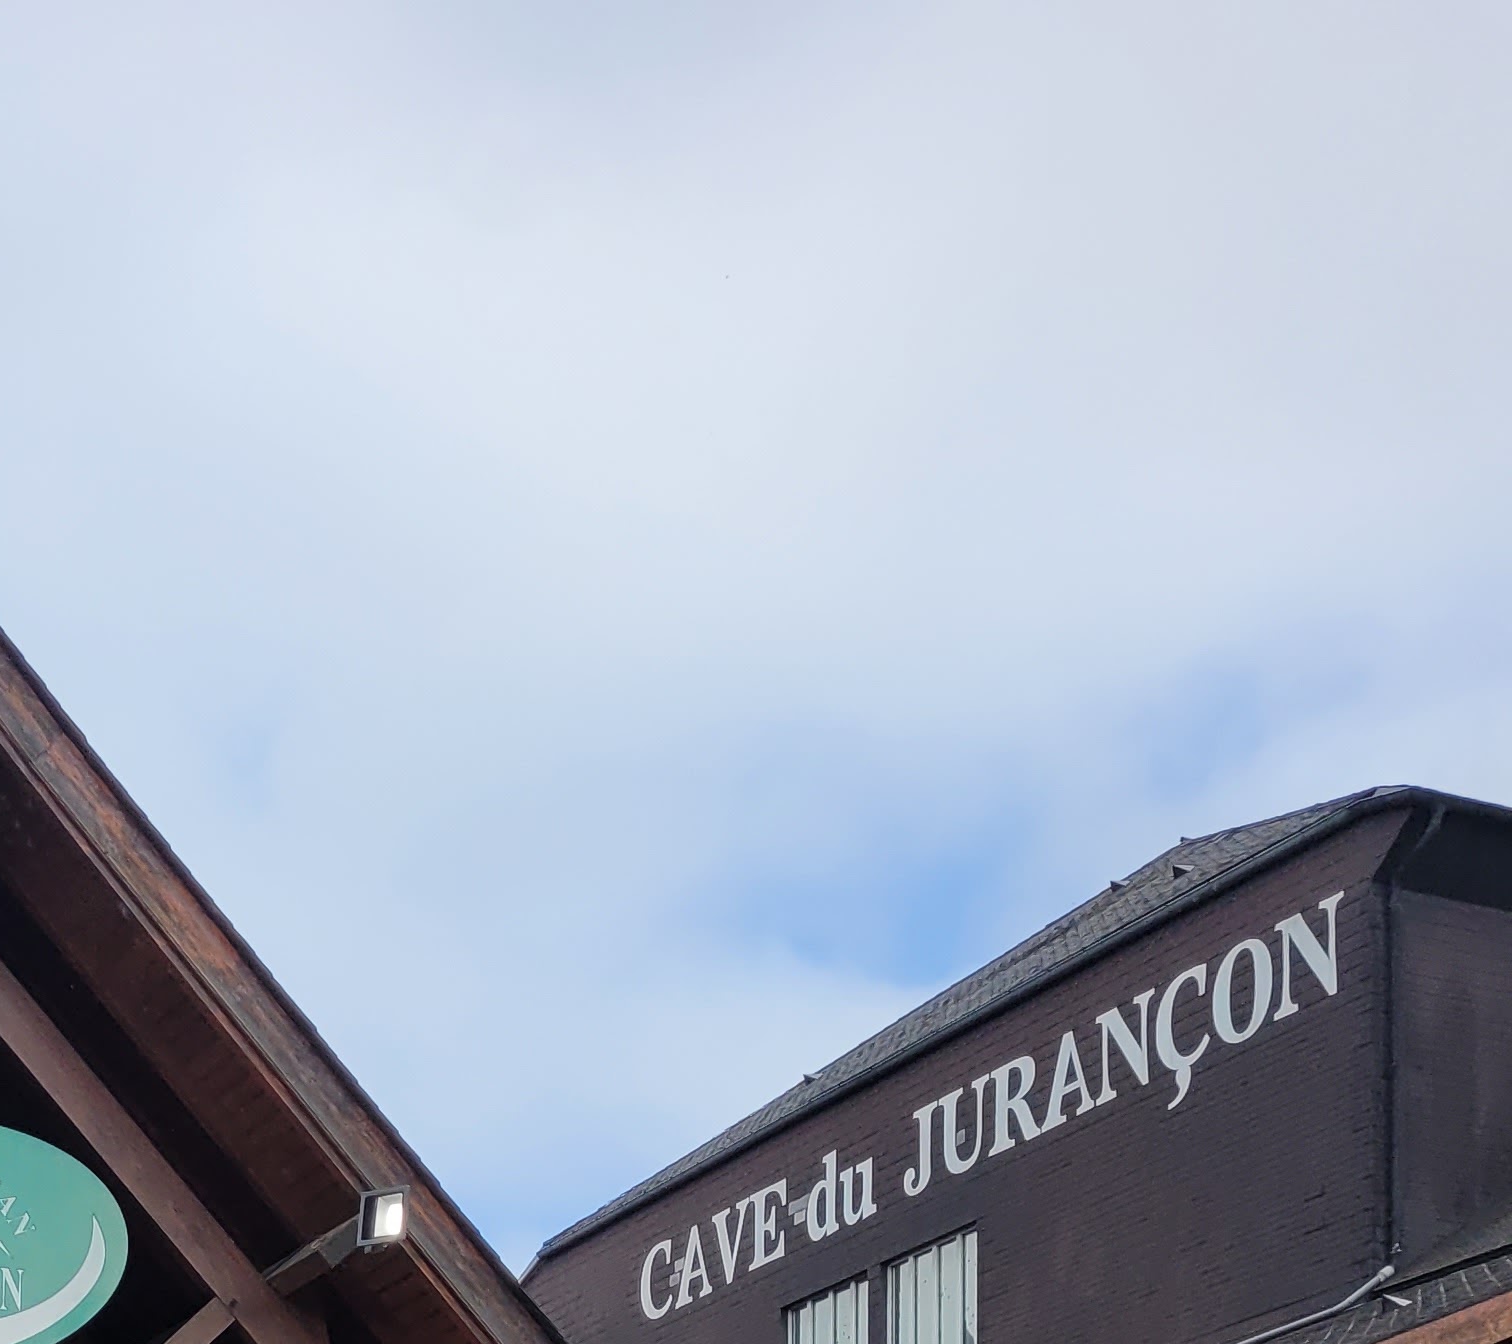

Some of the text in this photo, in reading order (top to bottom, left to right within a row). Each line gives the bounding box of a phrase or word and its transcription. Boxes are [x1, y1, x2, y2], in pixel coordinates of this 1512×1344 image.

[640, 890, 1345, 1320] CAVE du JURANÇON
